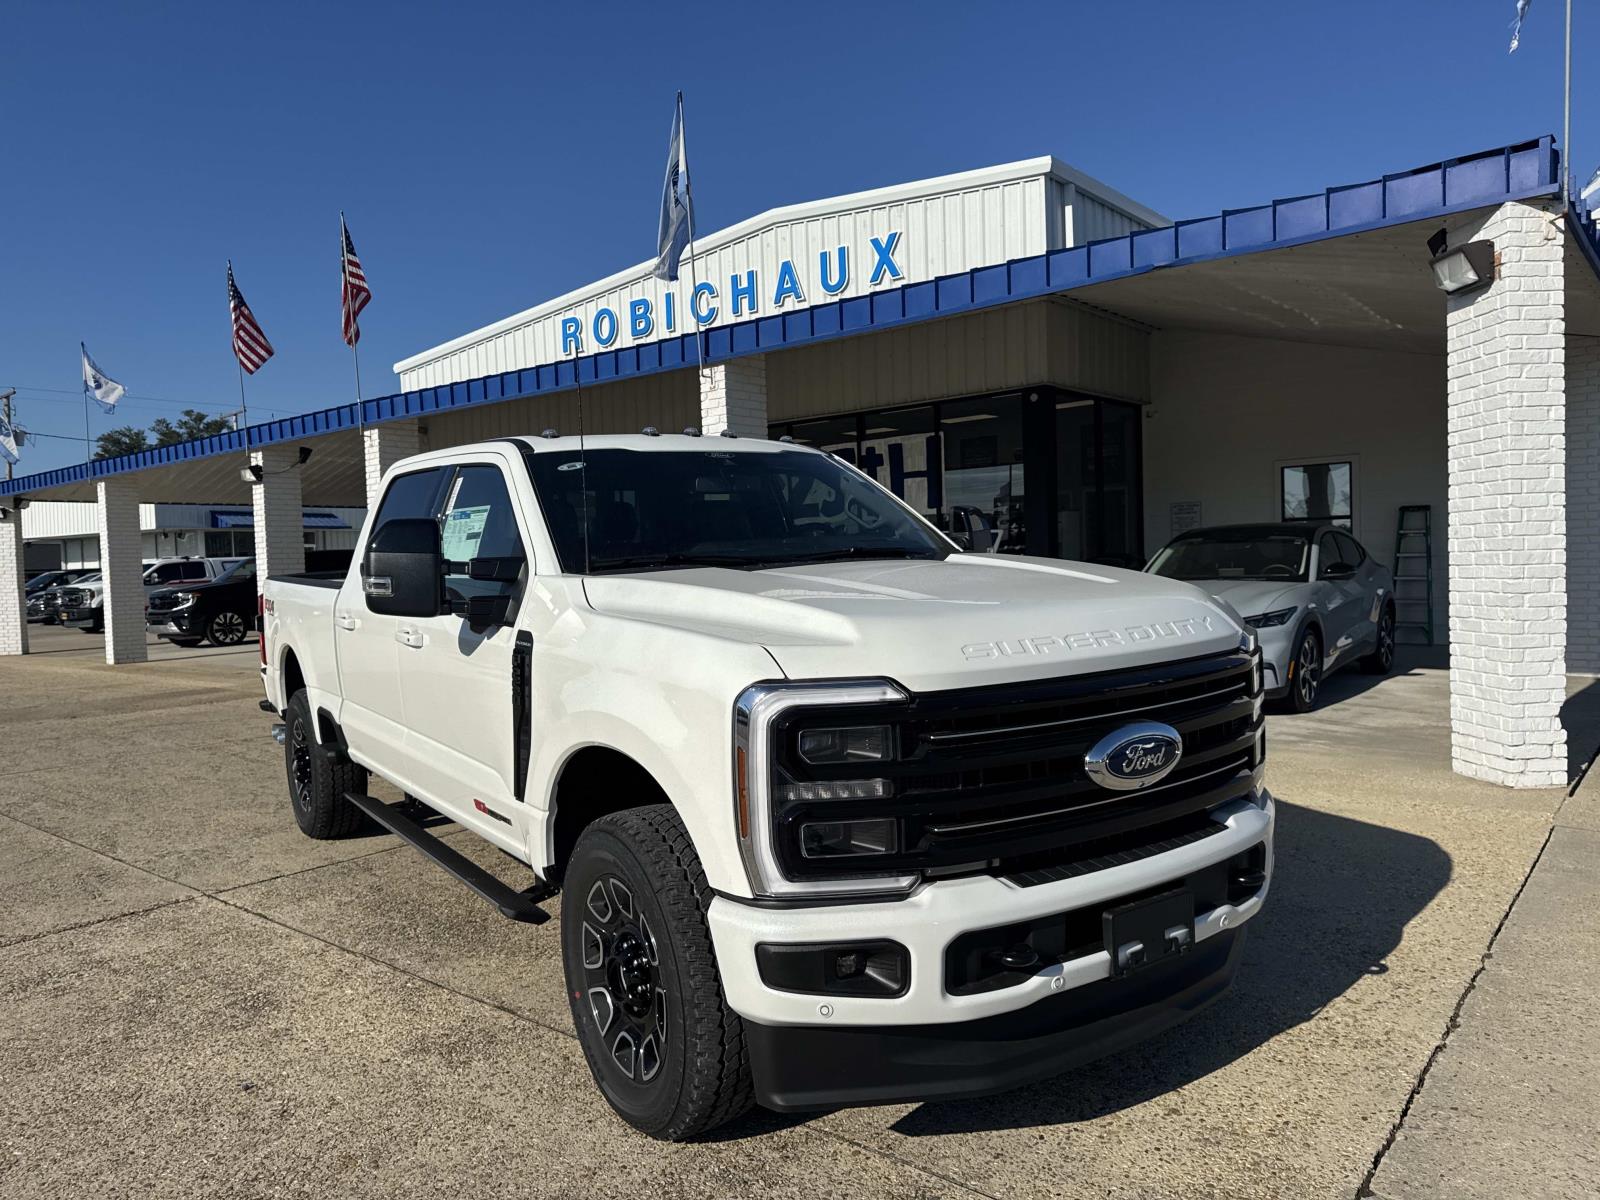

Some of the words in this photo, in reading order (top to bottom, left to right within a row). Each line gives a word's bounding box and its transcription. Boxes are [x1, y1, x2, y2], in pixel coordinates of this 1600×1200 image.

[562, 231, 904, 355] ROBICHAUX
[960, 629, 1126, 661] SUPER
[1124, 615, 1213, 643] DUTY
[1122, 741, 1166, 773] Ford
